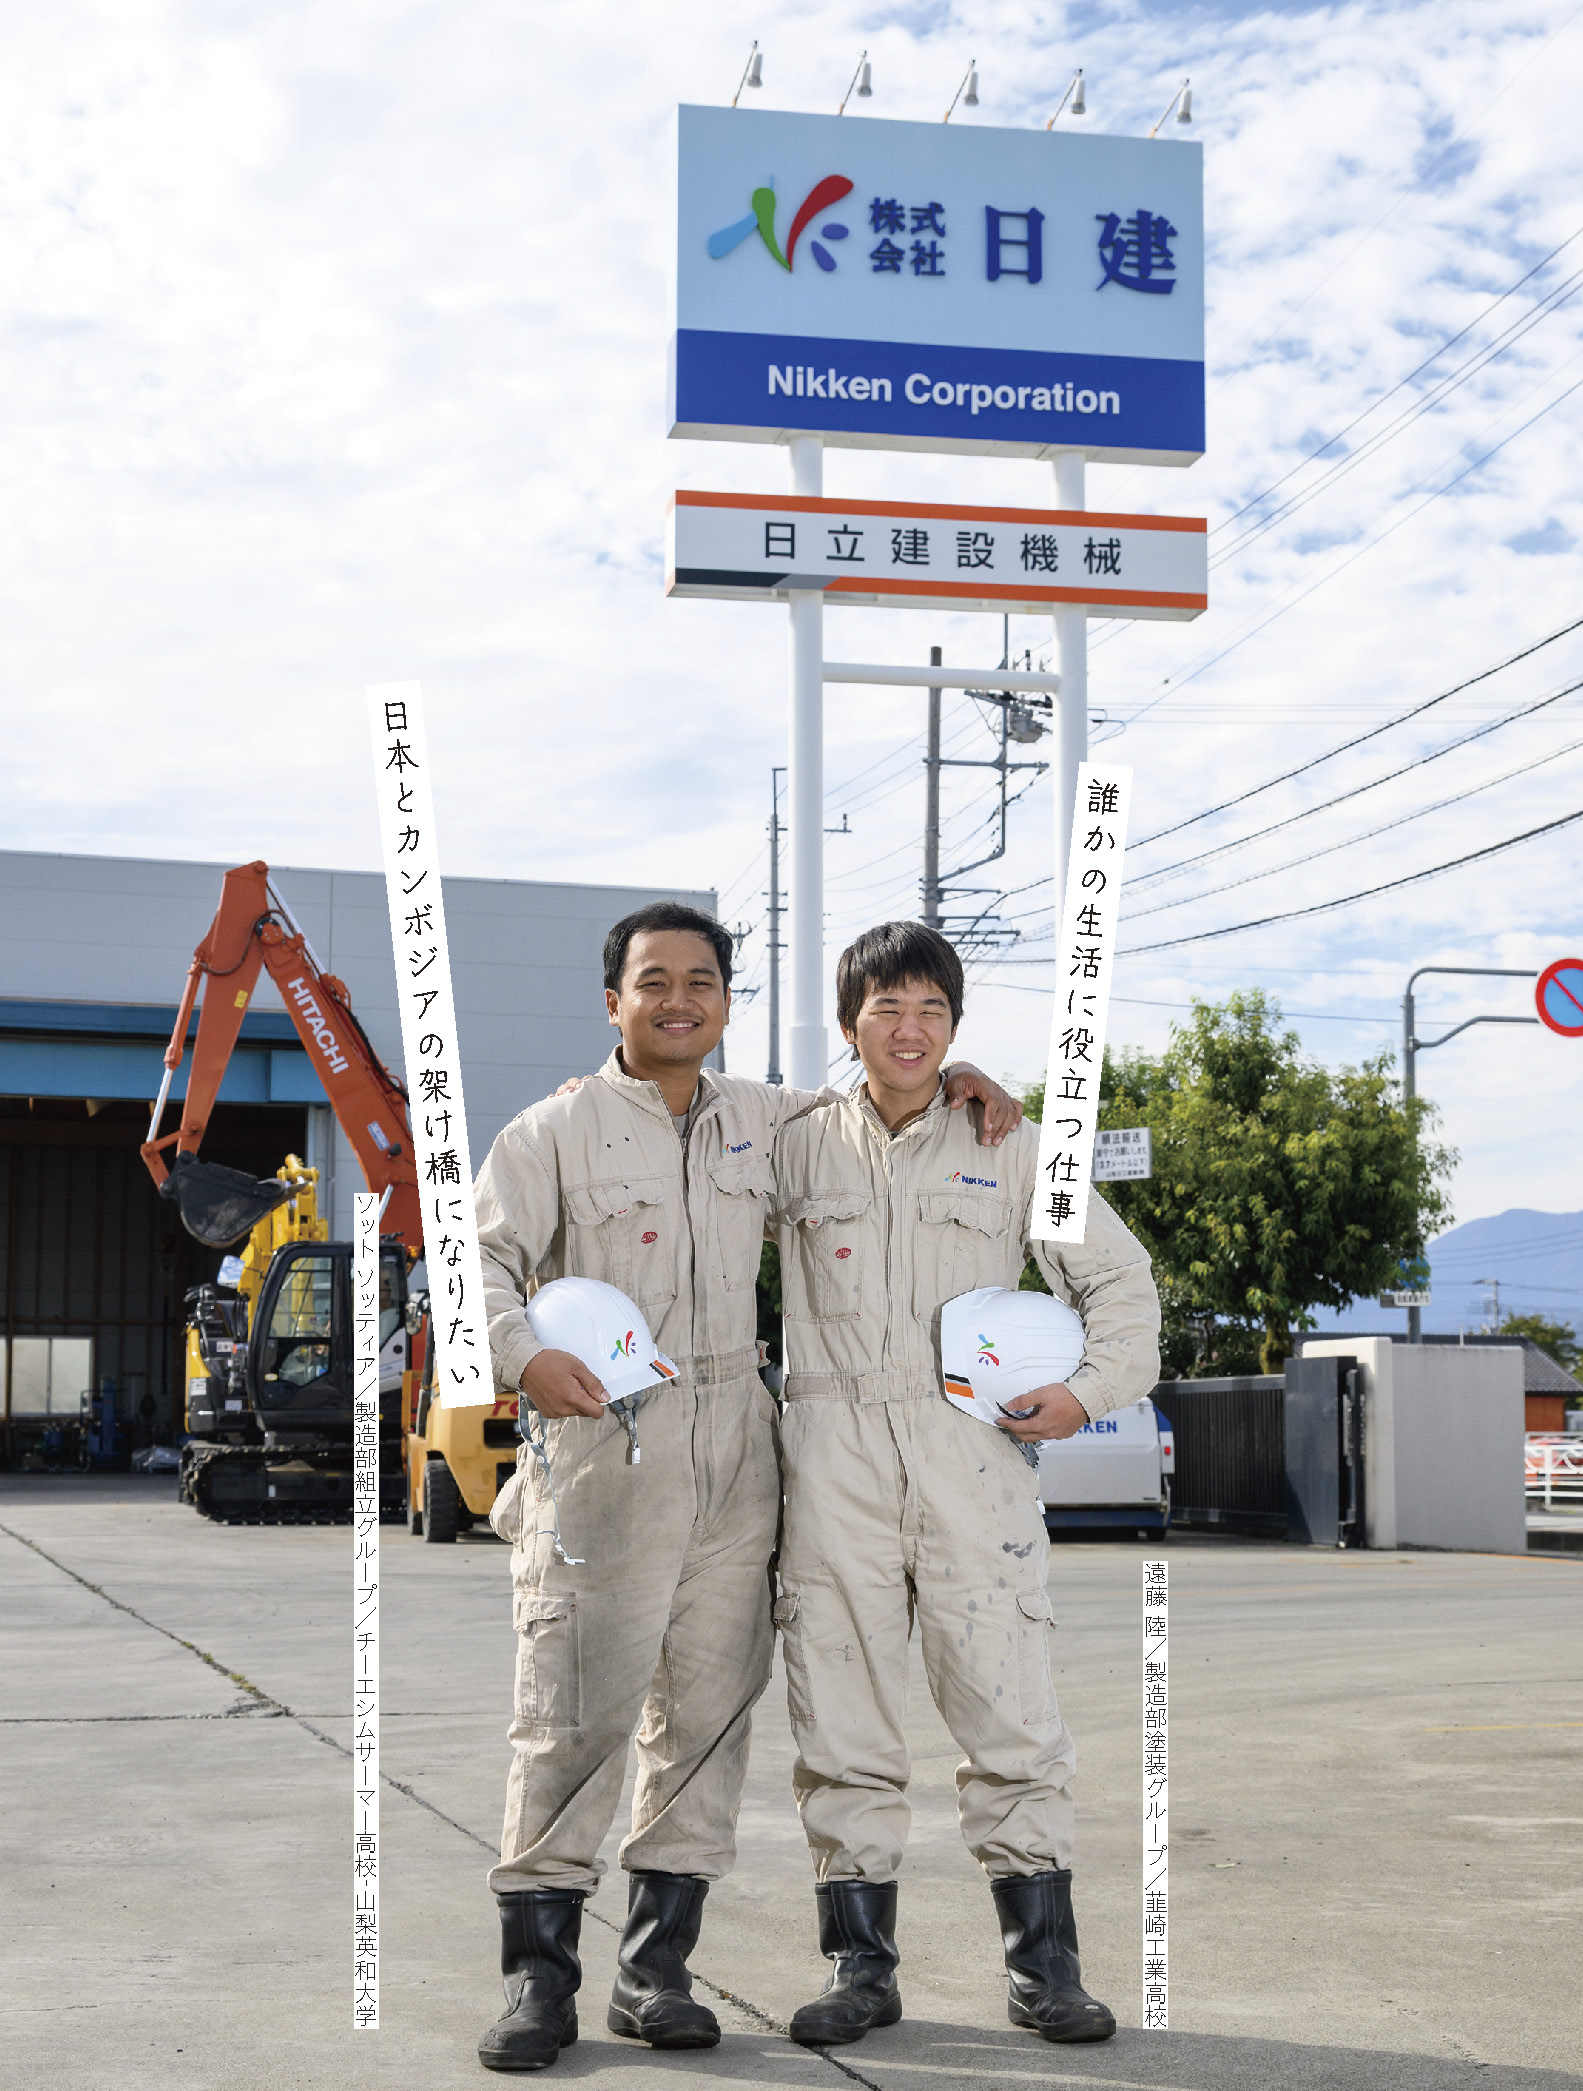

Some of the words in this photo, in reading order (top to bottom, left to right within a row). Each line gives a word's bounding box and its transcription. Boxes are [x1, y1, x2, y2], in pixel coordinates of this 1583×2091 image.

[868, 196, 946, 238] 株式
[868, 238, 946, 276] 会社
[984, 204, 1179, 296] 日建
[767, 364, 892, 402] Nikken
[904, 373, 1121, 415] Corporation
[763, 521, 1123, 576] 日立建設機械
[288, 977, 349, 1074] HITACHI
[961, 1175, 997, 1188] NIKKEN
[1079, 1421, 1117, 1434] KEN
